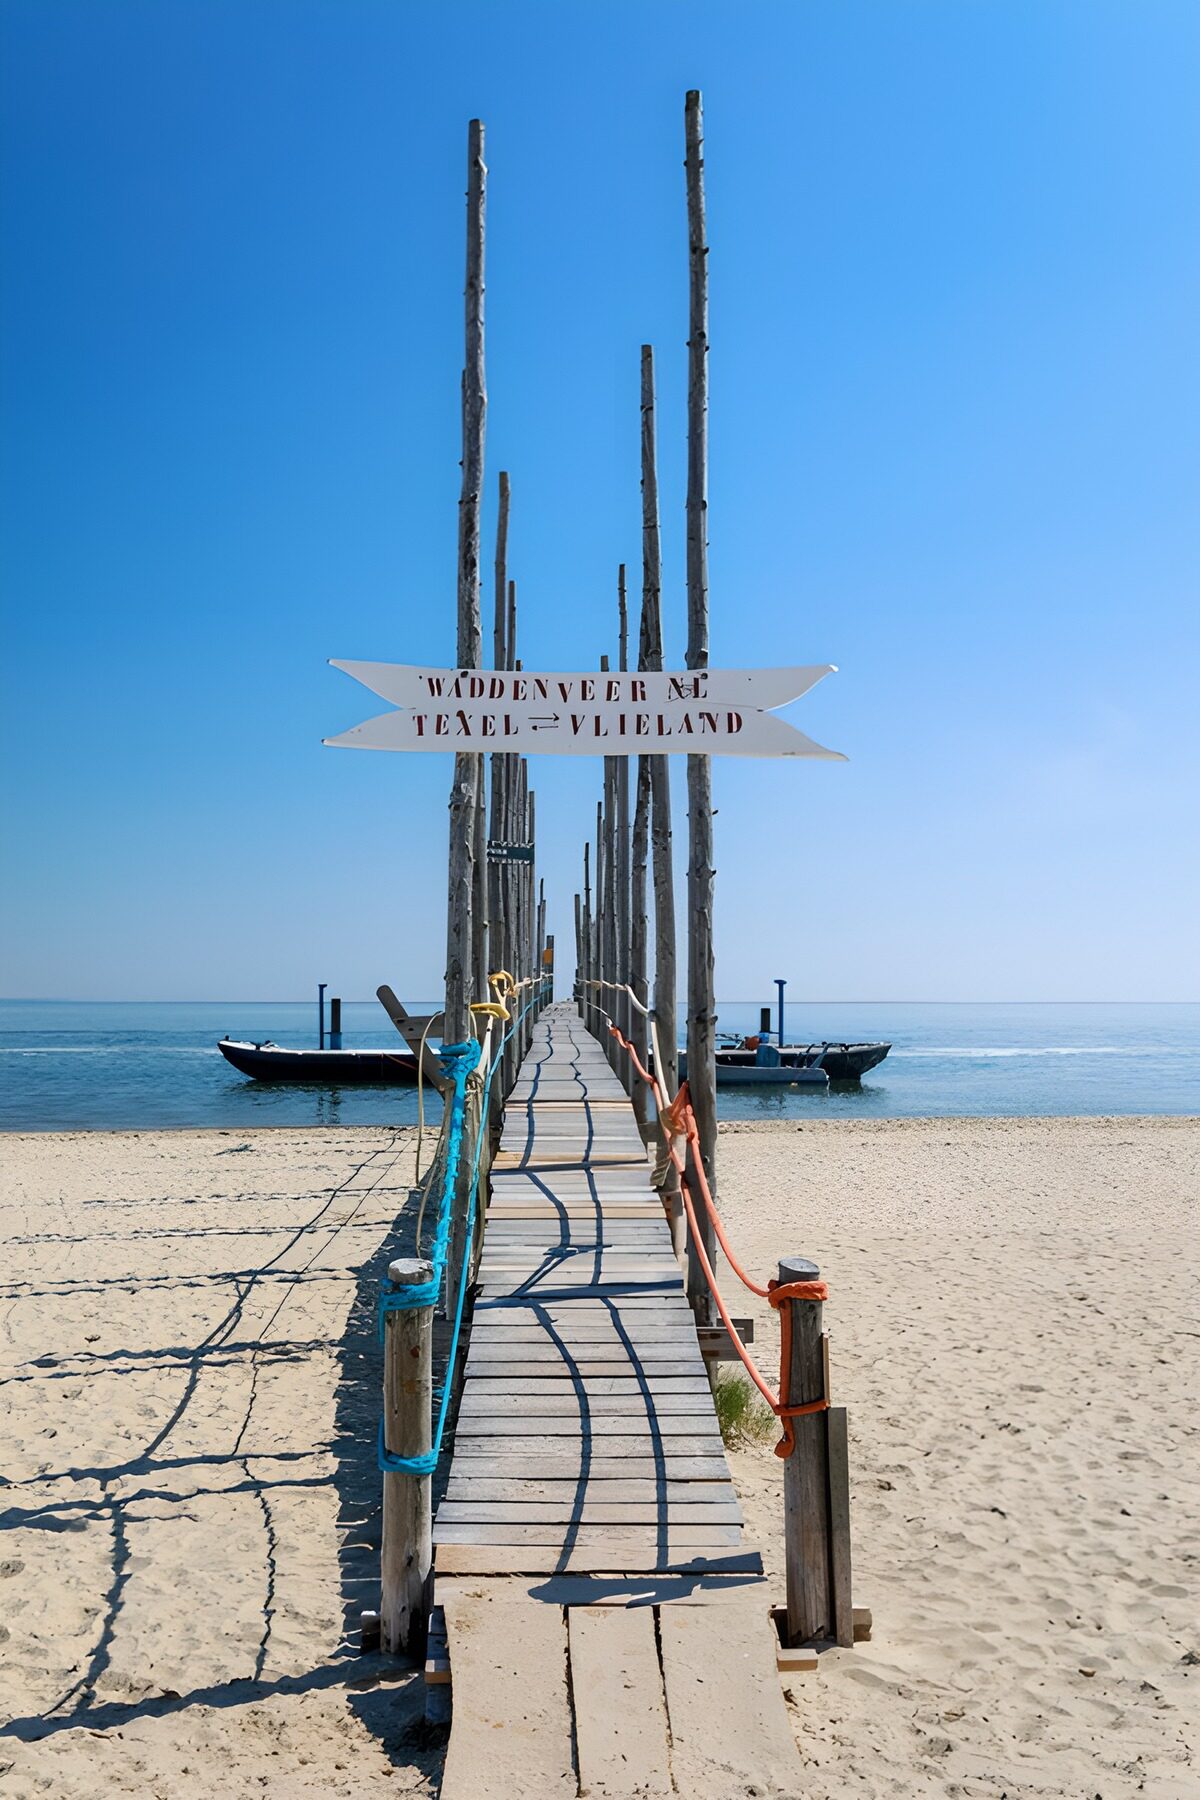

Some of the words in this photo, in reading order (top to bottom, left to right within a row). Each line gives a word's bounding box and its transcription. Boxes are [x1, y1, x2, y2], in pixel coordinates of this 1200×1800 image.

[428, 677, 647, 704] WADDENVEER
[412, 713, 519, 737] TEXEL
[570, 712, 744, 737] VLIELAND
